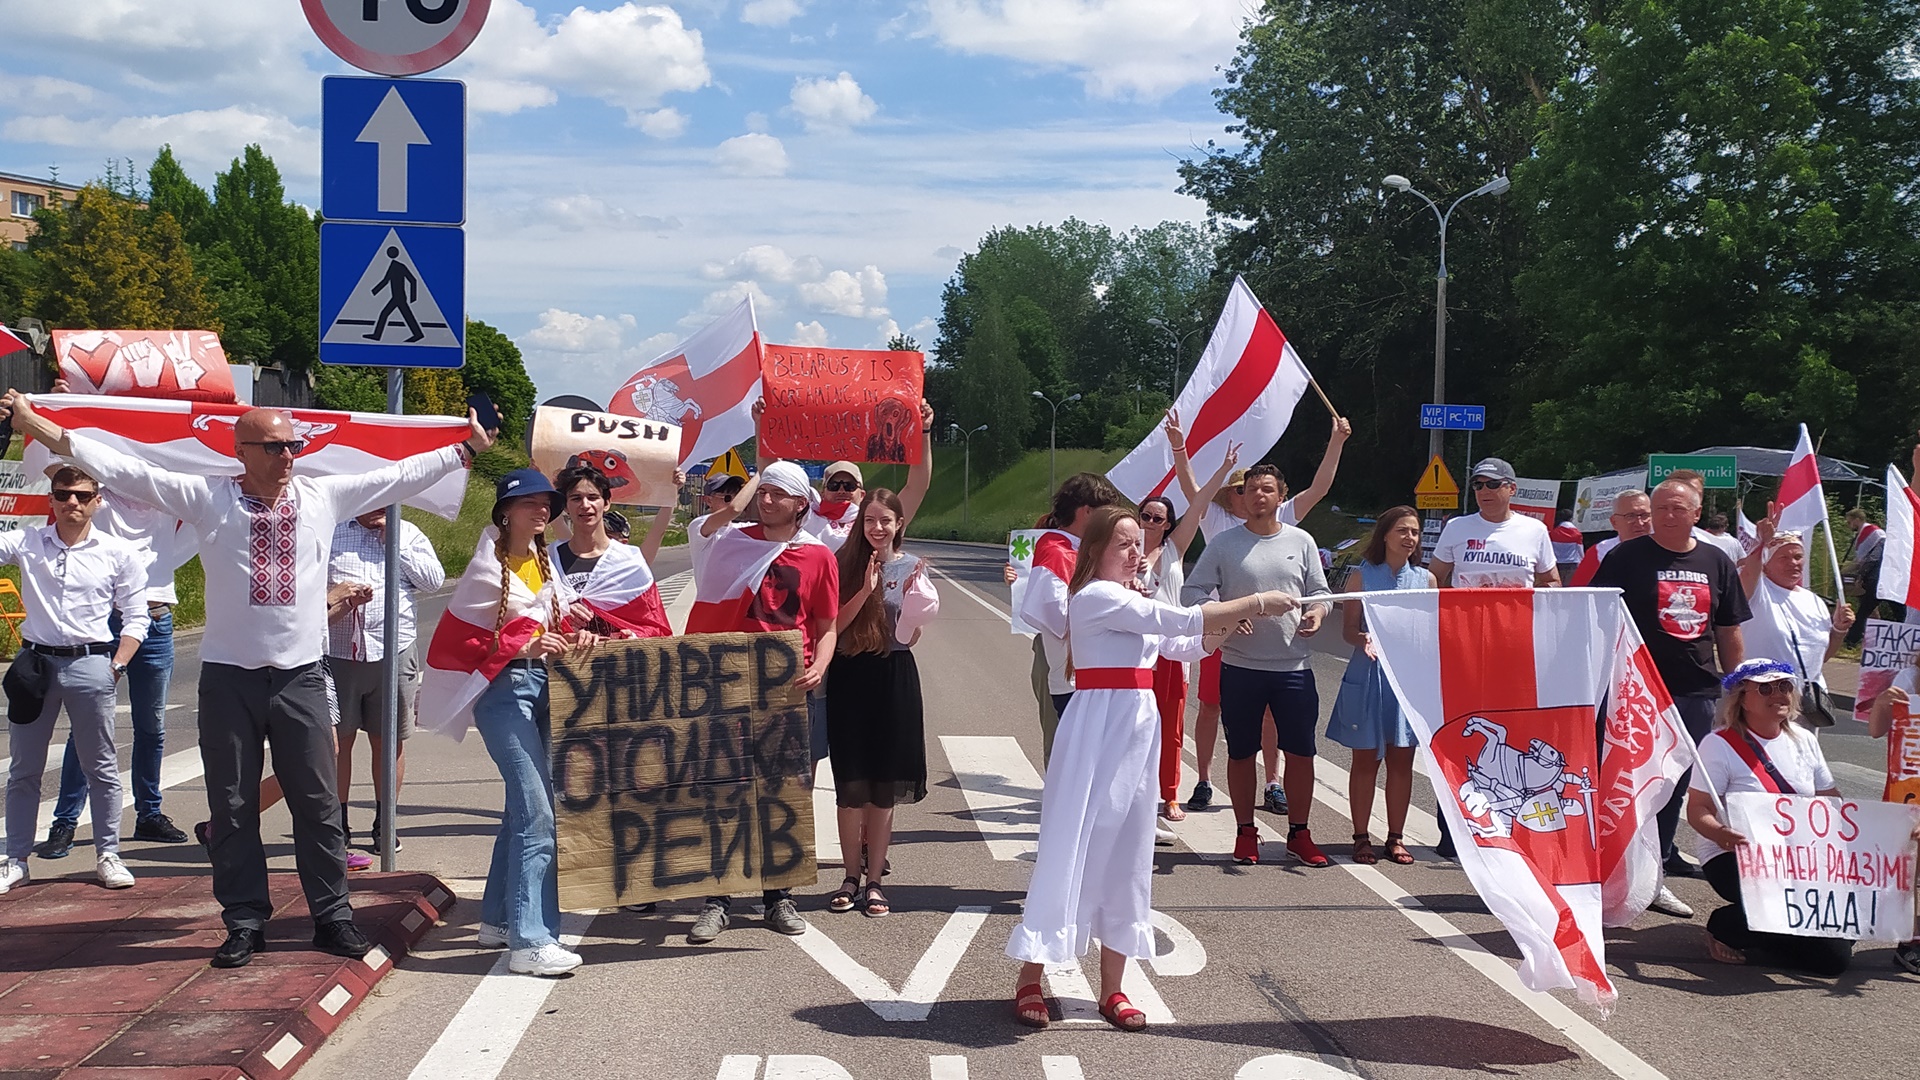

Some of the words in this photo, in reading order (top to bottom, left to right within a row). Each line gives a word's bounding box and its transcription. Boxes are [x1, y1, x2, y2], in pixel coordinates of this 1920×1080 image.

[774, 352, 849, 378] BELARUS
[869, 359, 894, 382] IS
[863, 387, 878, 403] IN
[1423, 417, 1443, 426] BUS
[1449, 413, 1462, 422] PC
[1467, 413, 1482, 422] TIR
[571, 412, 670, 441] PUSH
[1654, 465, 1732, 478] Bowniki
[1463, 551, 1529, 568] КУПАЛАЎЦЫ
[1657, 570, 1709, 584] BELARUS
[554, 637, 797, 729] УНИВЕР
[1773, 797, 1860, 842] SOS
[612, 797, 804, 899] РЕЙВ
